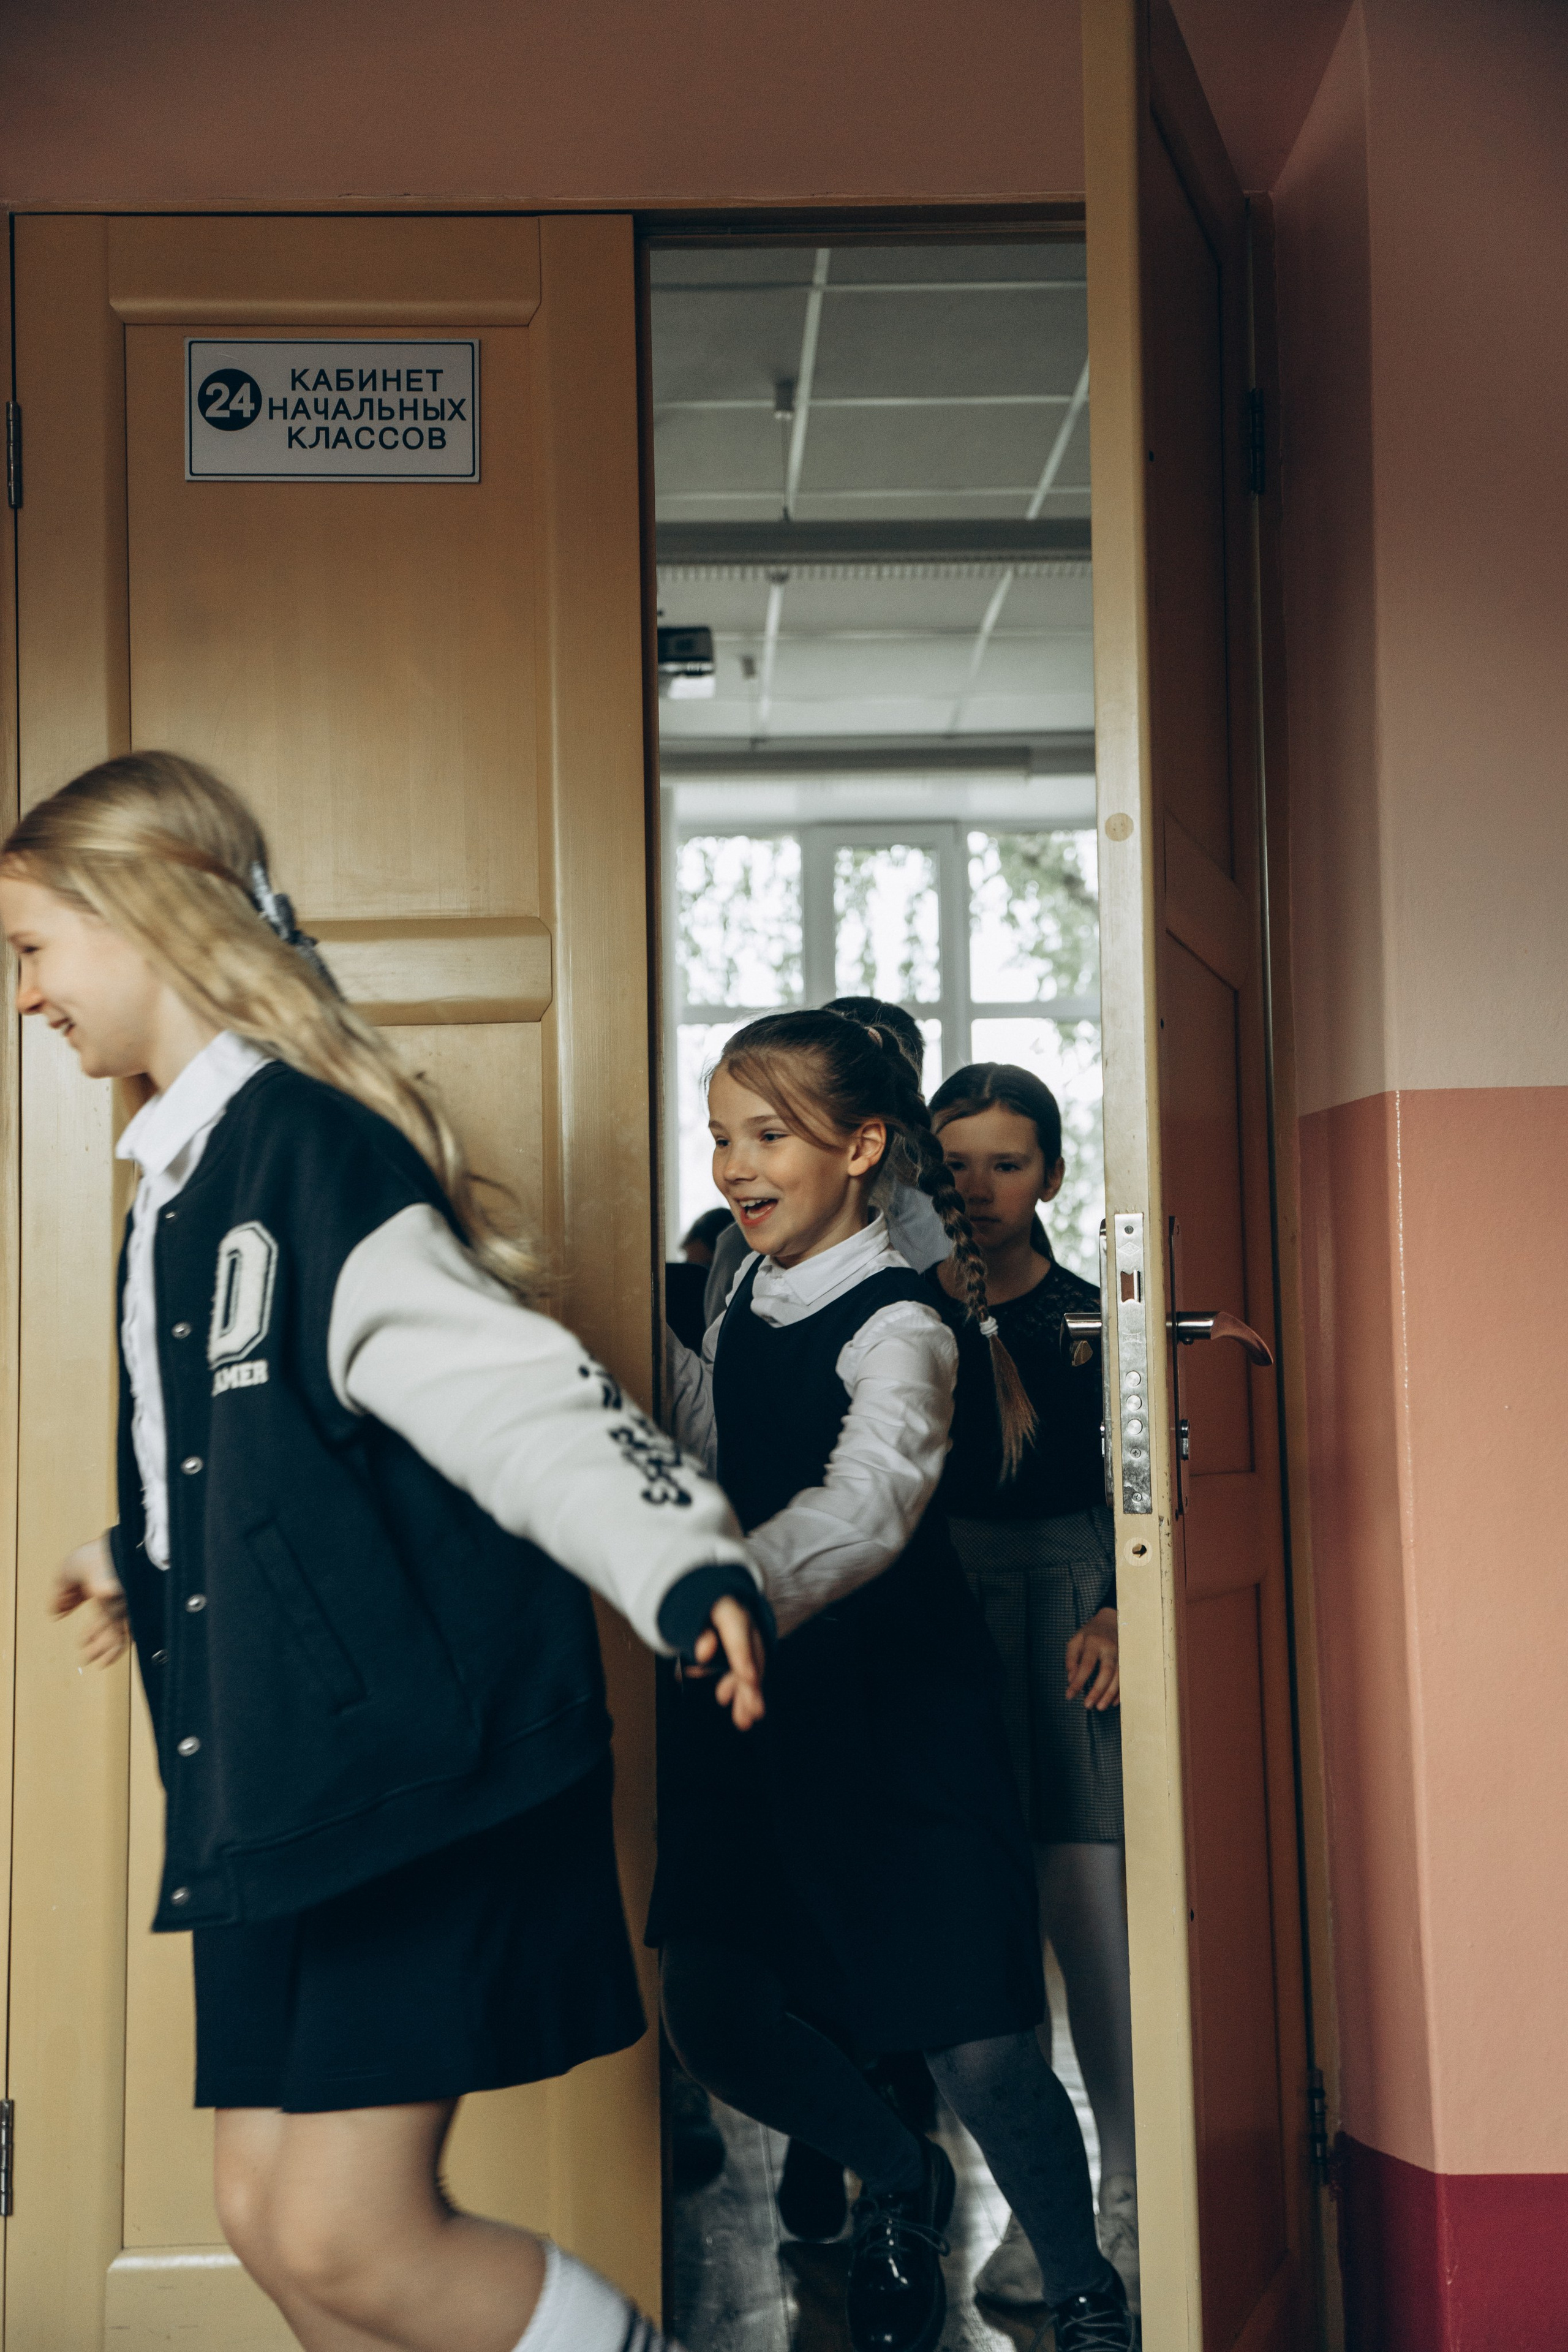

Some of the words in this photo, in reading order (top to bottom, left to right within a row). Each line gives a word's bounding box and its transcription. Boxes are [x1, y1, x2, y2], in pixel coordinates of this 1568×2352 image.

[291, 368, 443, 392] КАБИНЕТ
[206, 382, 255, 418] 24
[268, 397, 467, 421] НАЧАЛЬНЫХ
[288, 426, 447, 450] КЛАССОВ
